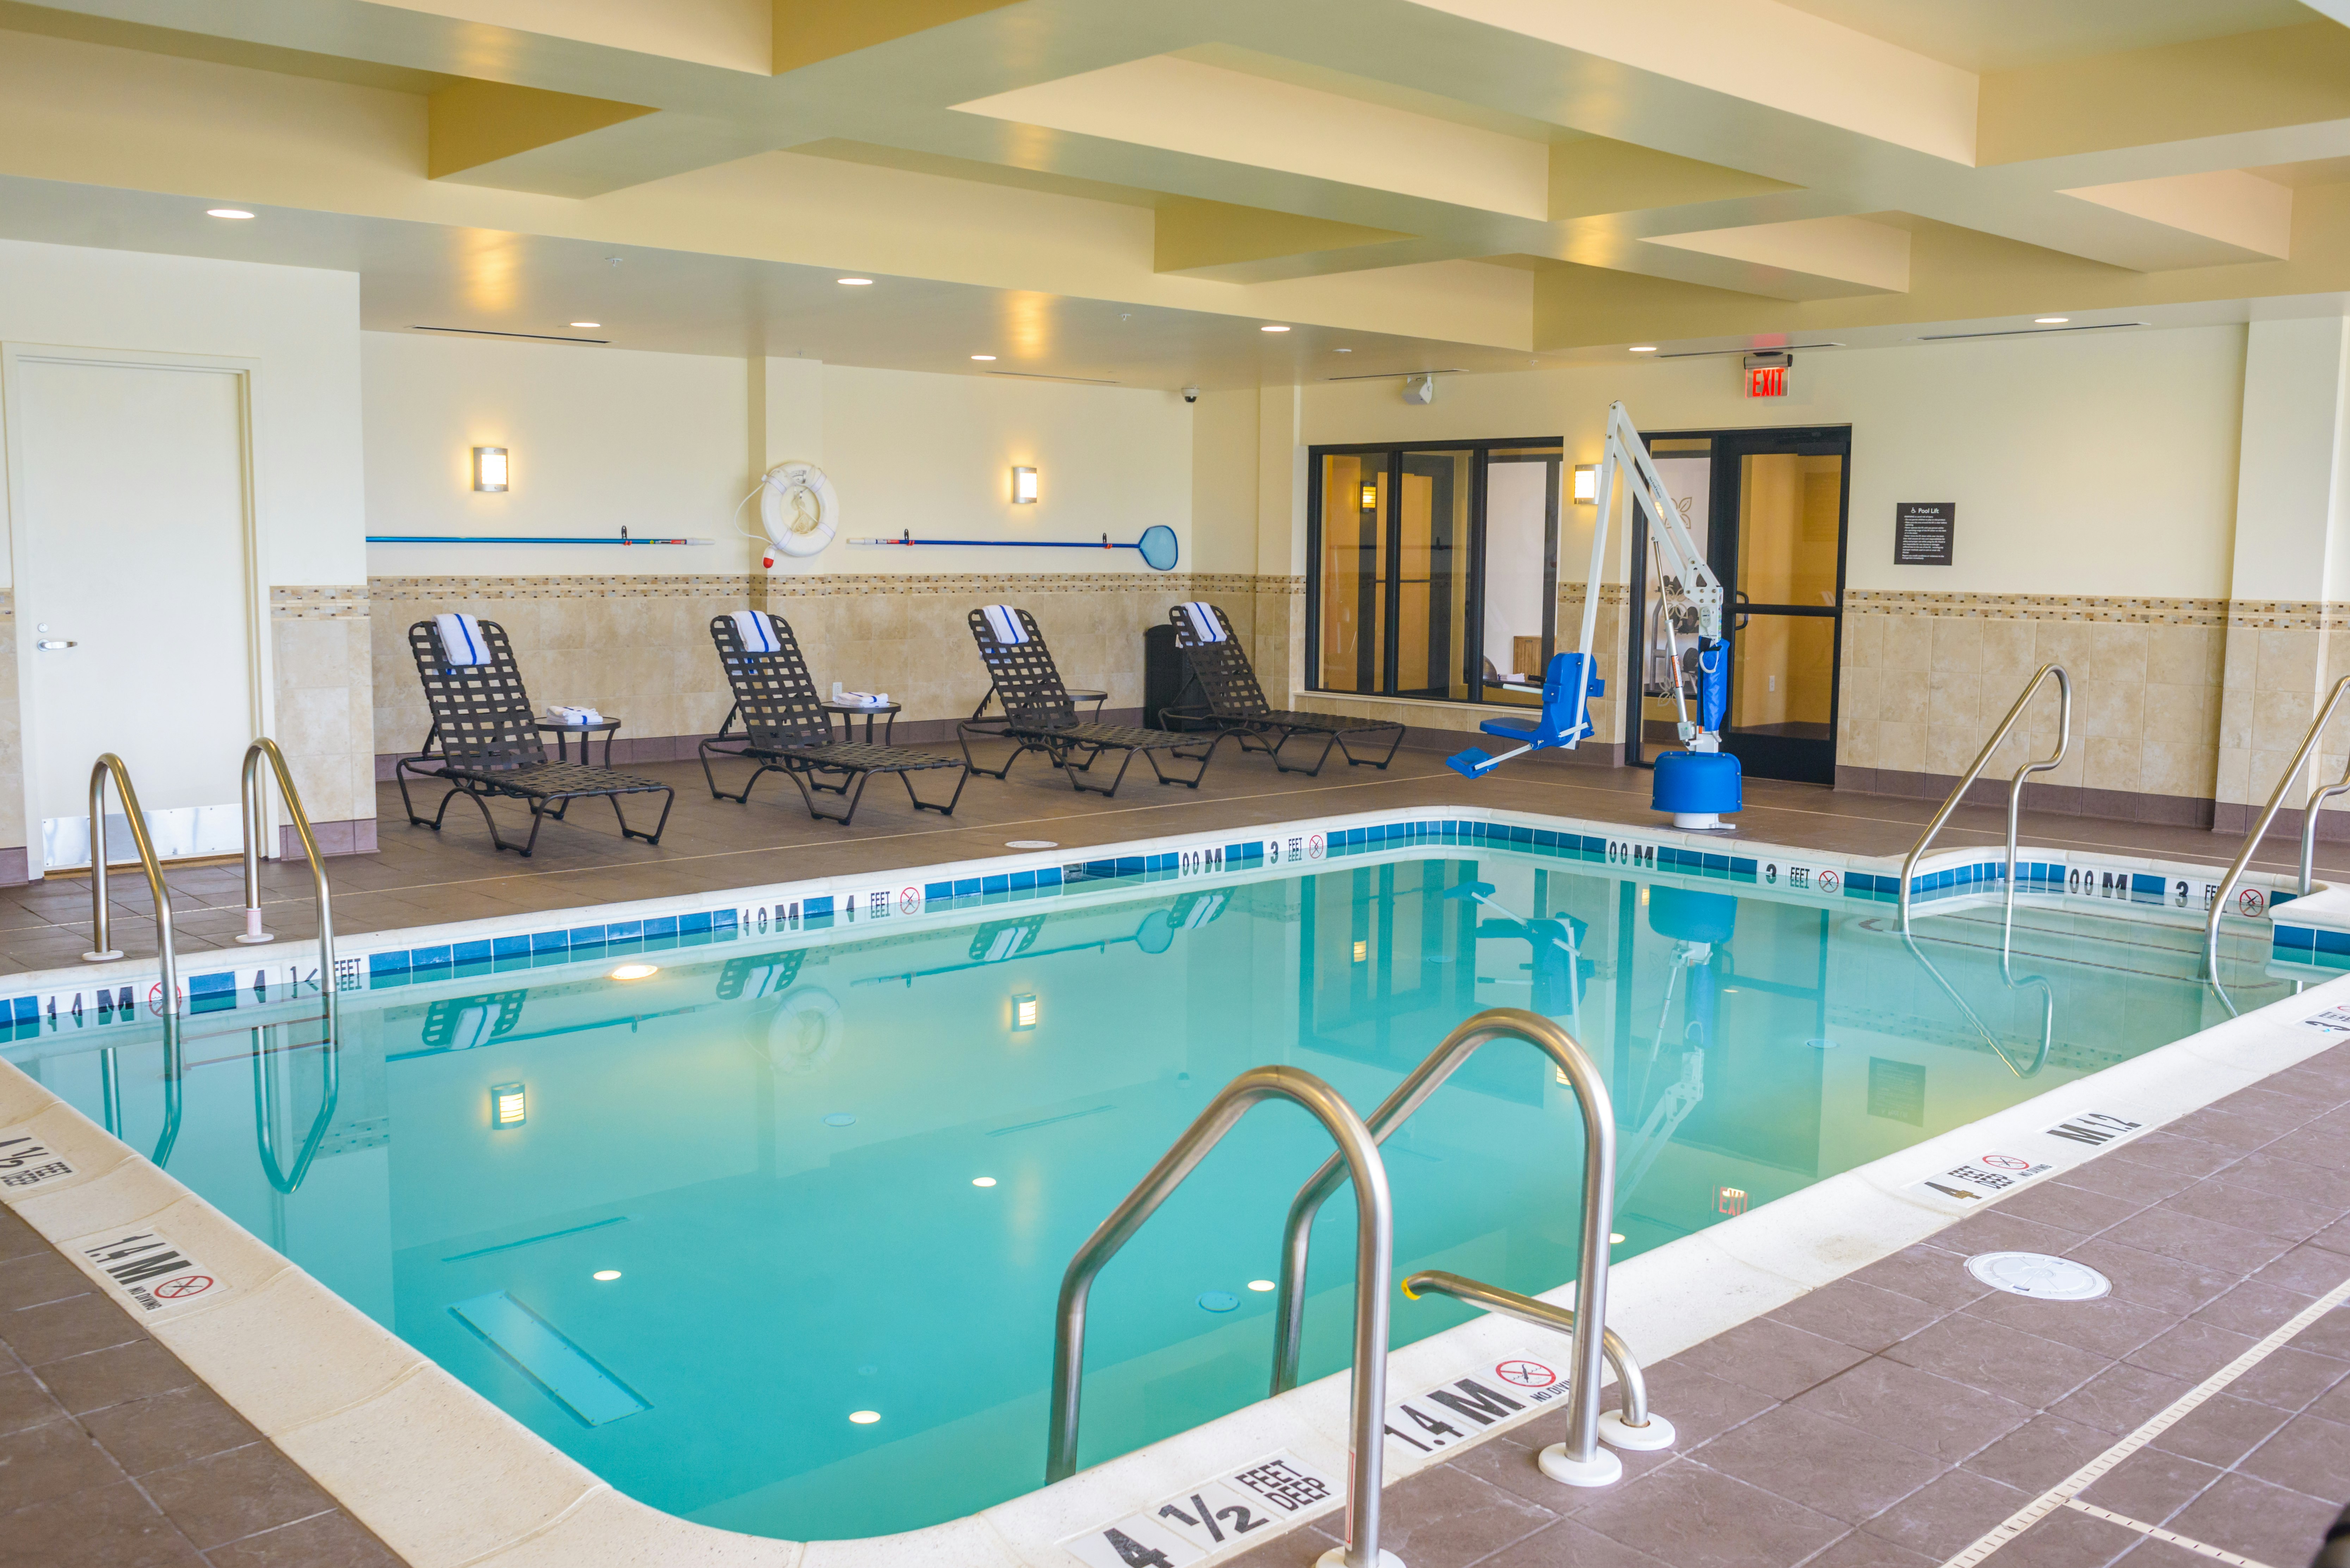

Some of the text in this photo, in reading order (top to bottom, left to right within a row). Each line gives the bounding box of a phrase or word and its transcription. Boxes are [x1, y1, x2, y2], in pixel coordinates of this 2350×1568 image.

[1752, 368, 1785, 397] EXIT
[1271, 837, 1302, 860] 3 FEET
[1790, 867, 1810, 885] FEET
[870, 891, 890, 914] FEET
[2175, 881, 2189, 903] 3
[2046, 1113, 2143, 1146] M 1.2
[0, 1170, 41, 1186] DEEP
[32, 1162, 73, 1179] FEET
[2025, 1164, 2053, 1174] DIVING
[1924, 1165, 1989, 1200] 4 FEET
[1973, 1173, 2016, 1189] DEEP
[84, 1234, 192, 1285] 1.4 M
[127, 1286, 147, 1295] NO
[134, 1293, 162, 1310] DIVING
[1529, 1391, 1552, 1402] NO
[1546, 1379, 1570, 1395] DIVI
[1384, 1378, 1527, 1452] 1.4 M
[1263, 1476, 1331, 1511] DEEP
[1103, 1527, 1175, 1568] 4
[1234, 1459, 1303, 1493] FEET
